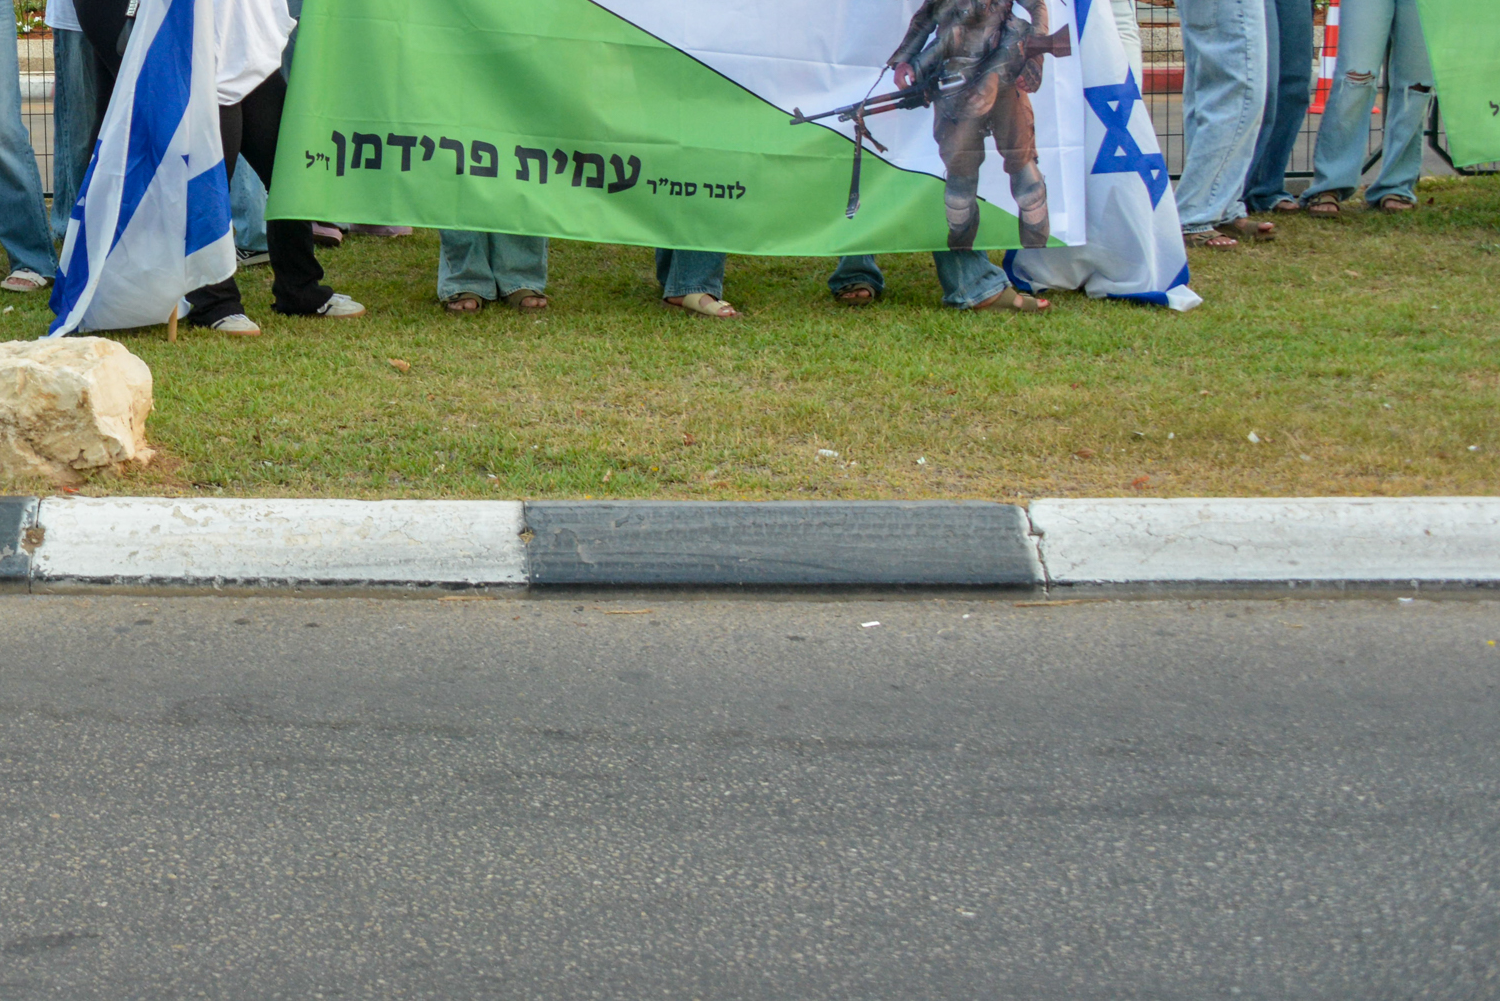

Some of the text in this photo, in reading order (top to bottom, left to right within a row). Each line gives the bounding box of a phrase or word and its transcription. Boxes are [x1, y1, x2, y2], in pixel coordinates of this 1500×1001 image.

[331, 130, 499, 178] פרידמן
[514, 145, 642, 194] עמית
[703, 181, 746, 200] לזכר
